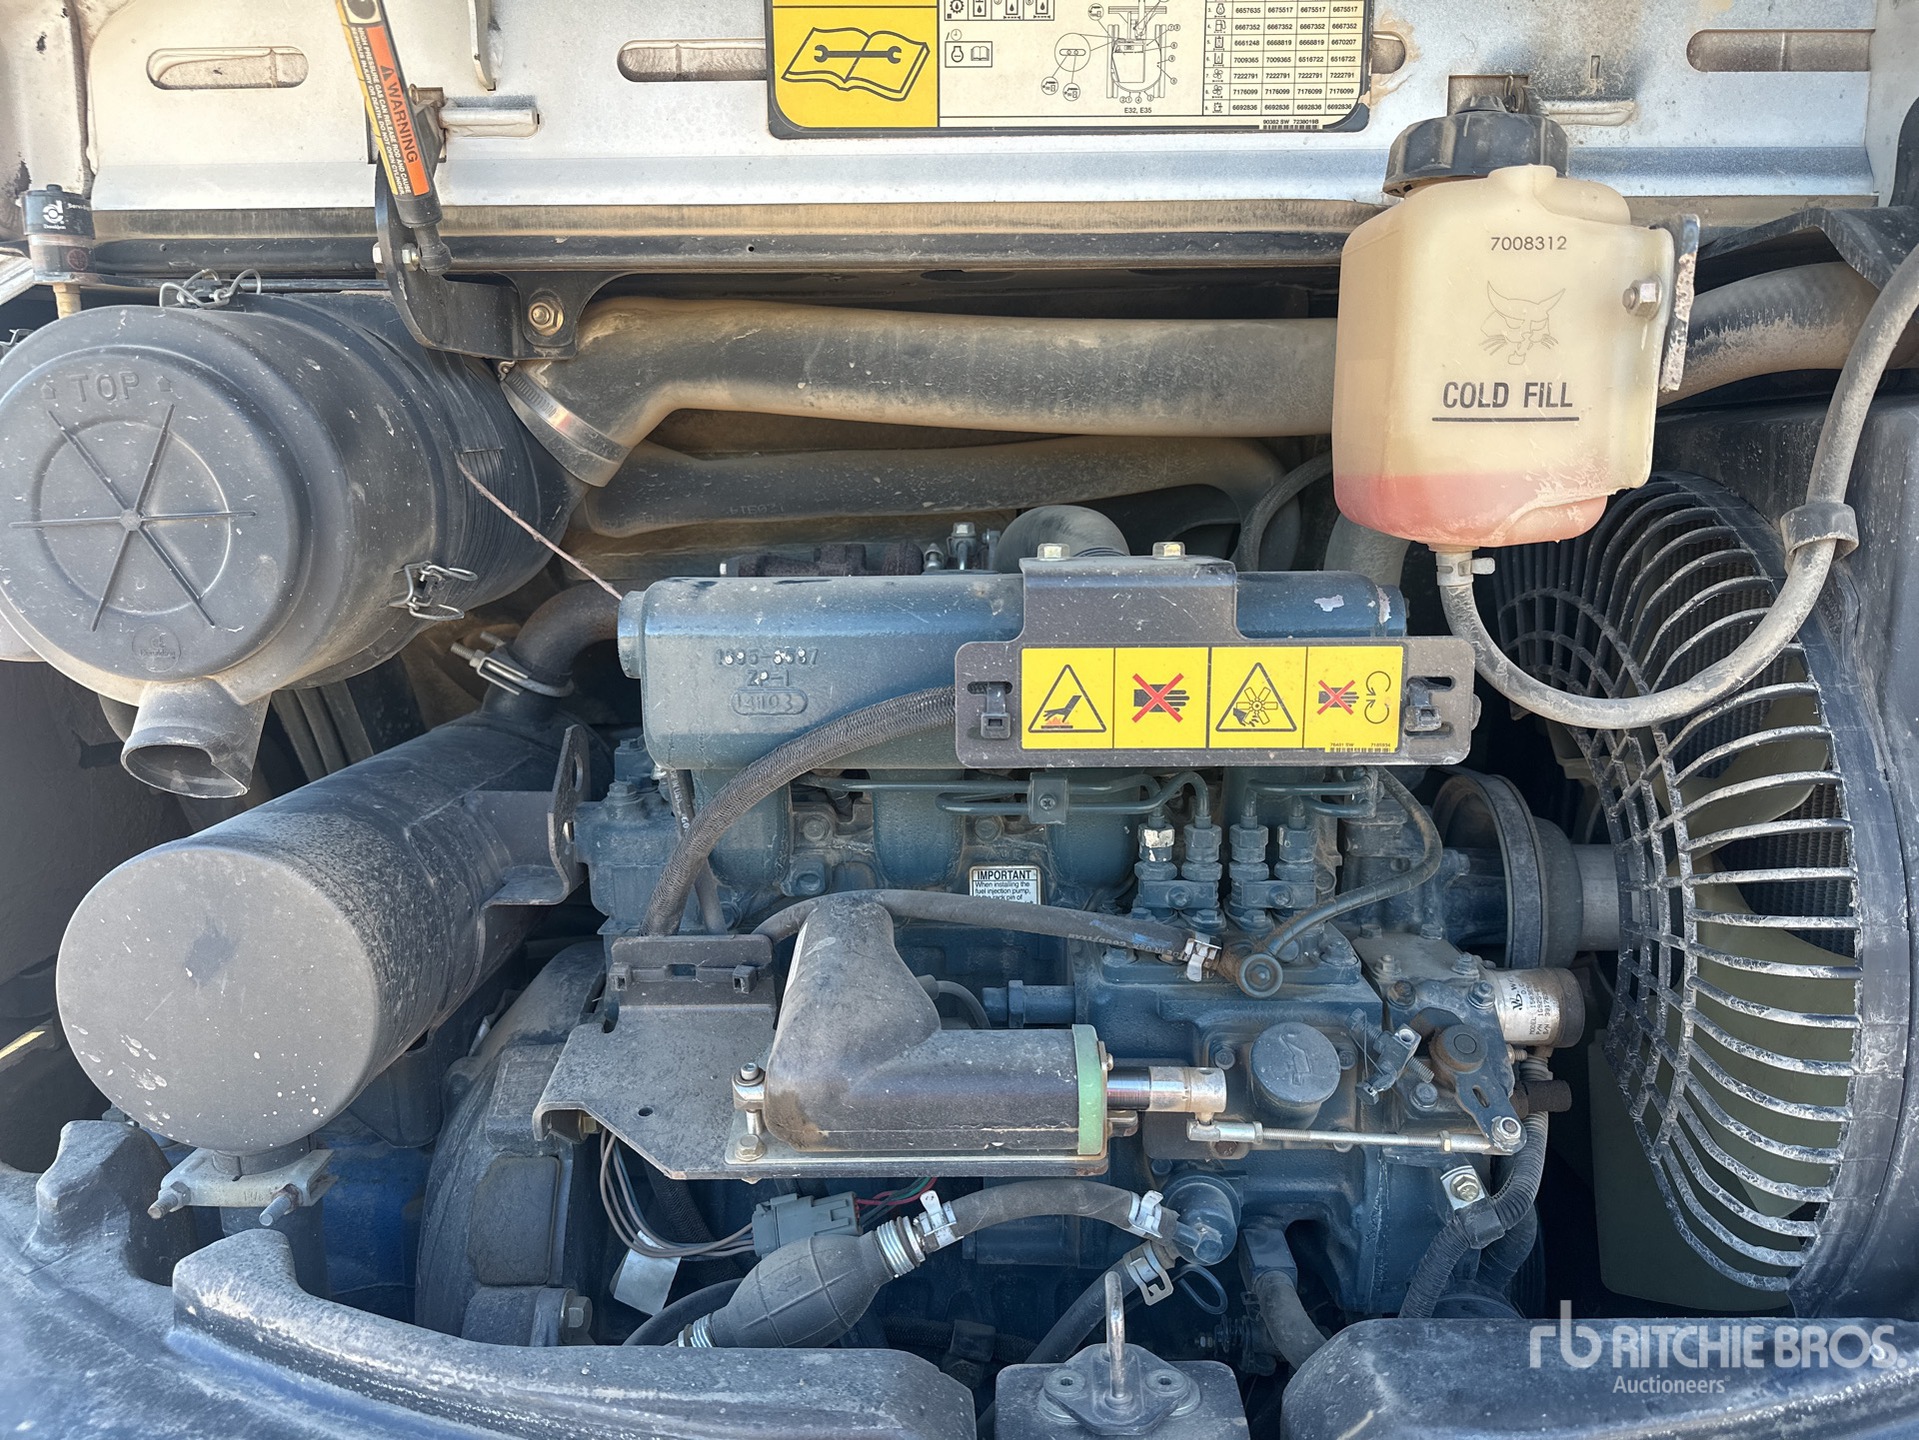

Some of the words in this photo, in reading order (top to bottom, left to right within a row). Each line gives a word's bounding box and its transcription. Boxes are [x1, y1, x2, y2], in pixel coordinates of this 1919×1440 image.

[365, 46, 378, 83] PRESSURE
[351, 27, 365, 59] SERIOUS
[360, 60, 373, 85] INJURY
[368, 85, 376, 96] OR
[378, 120, 386, 131] DO
[382, 131, 390, 146] NOT
[386, 146, 396, 164] OPEN
[375, 84, 384, 99] GAS
[379, 99, 388, 114] CAN
[383, 114, 396, 144] RELEASE
[387, 82, 418, 163] WARNING
[392, 144, 401, 159] ROD
[396, 158, 405, 173] AND
[400, 173, 411, 194] CAUSE
[1490, 236, 1568, 251] 7008312
[66, 371, 140, 402] TOP
[1443, 382, 1510, 408] COLD
[1524, 382, 1574, 408] FILL
[977, 870, 1032, 880] IMPORTANT
